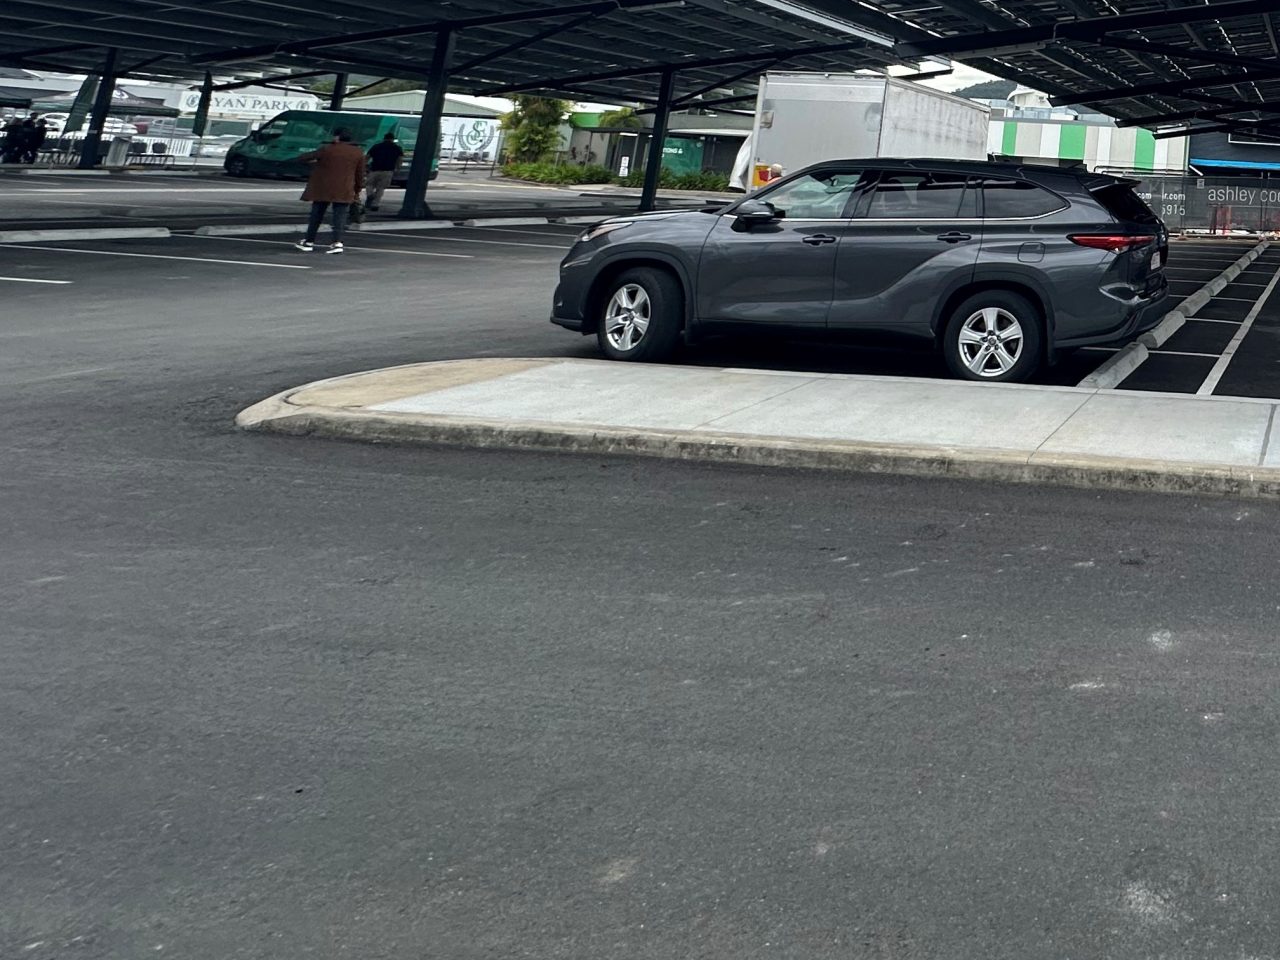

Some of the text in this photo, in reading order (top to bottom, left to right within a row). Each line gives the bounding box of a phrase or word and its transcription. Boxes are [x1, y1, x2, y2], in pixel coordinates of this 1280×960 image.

[214, 97, 294, 110] YAN PARK
[1207, 185, 1256, 205] ashley
